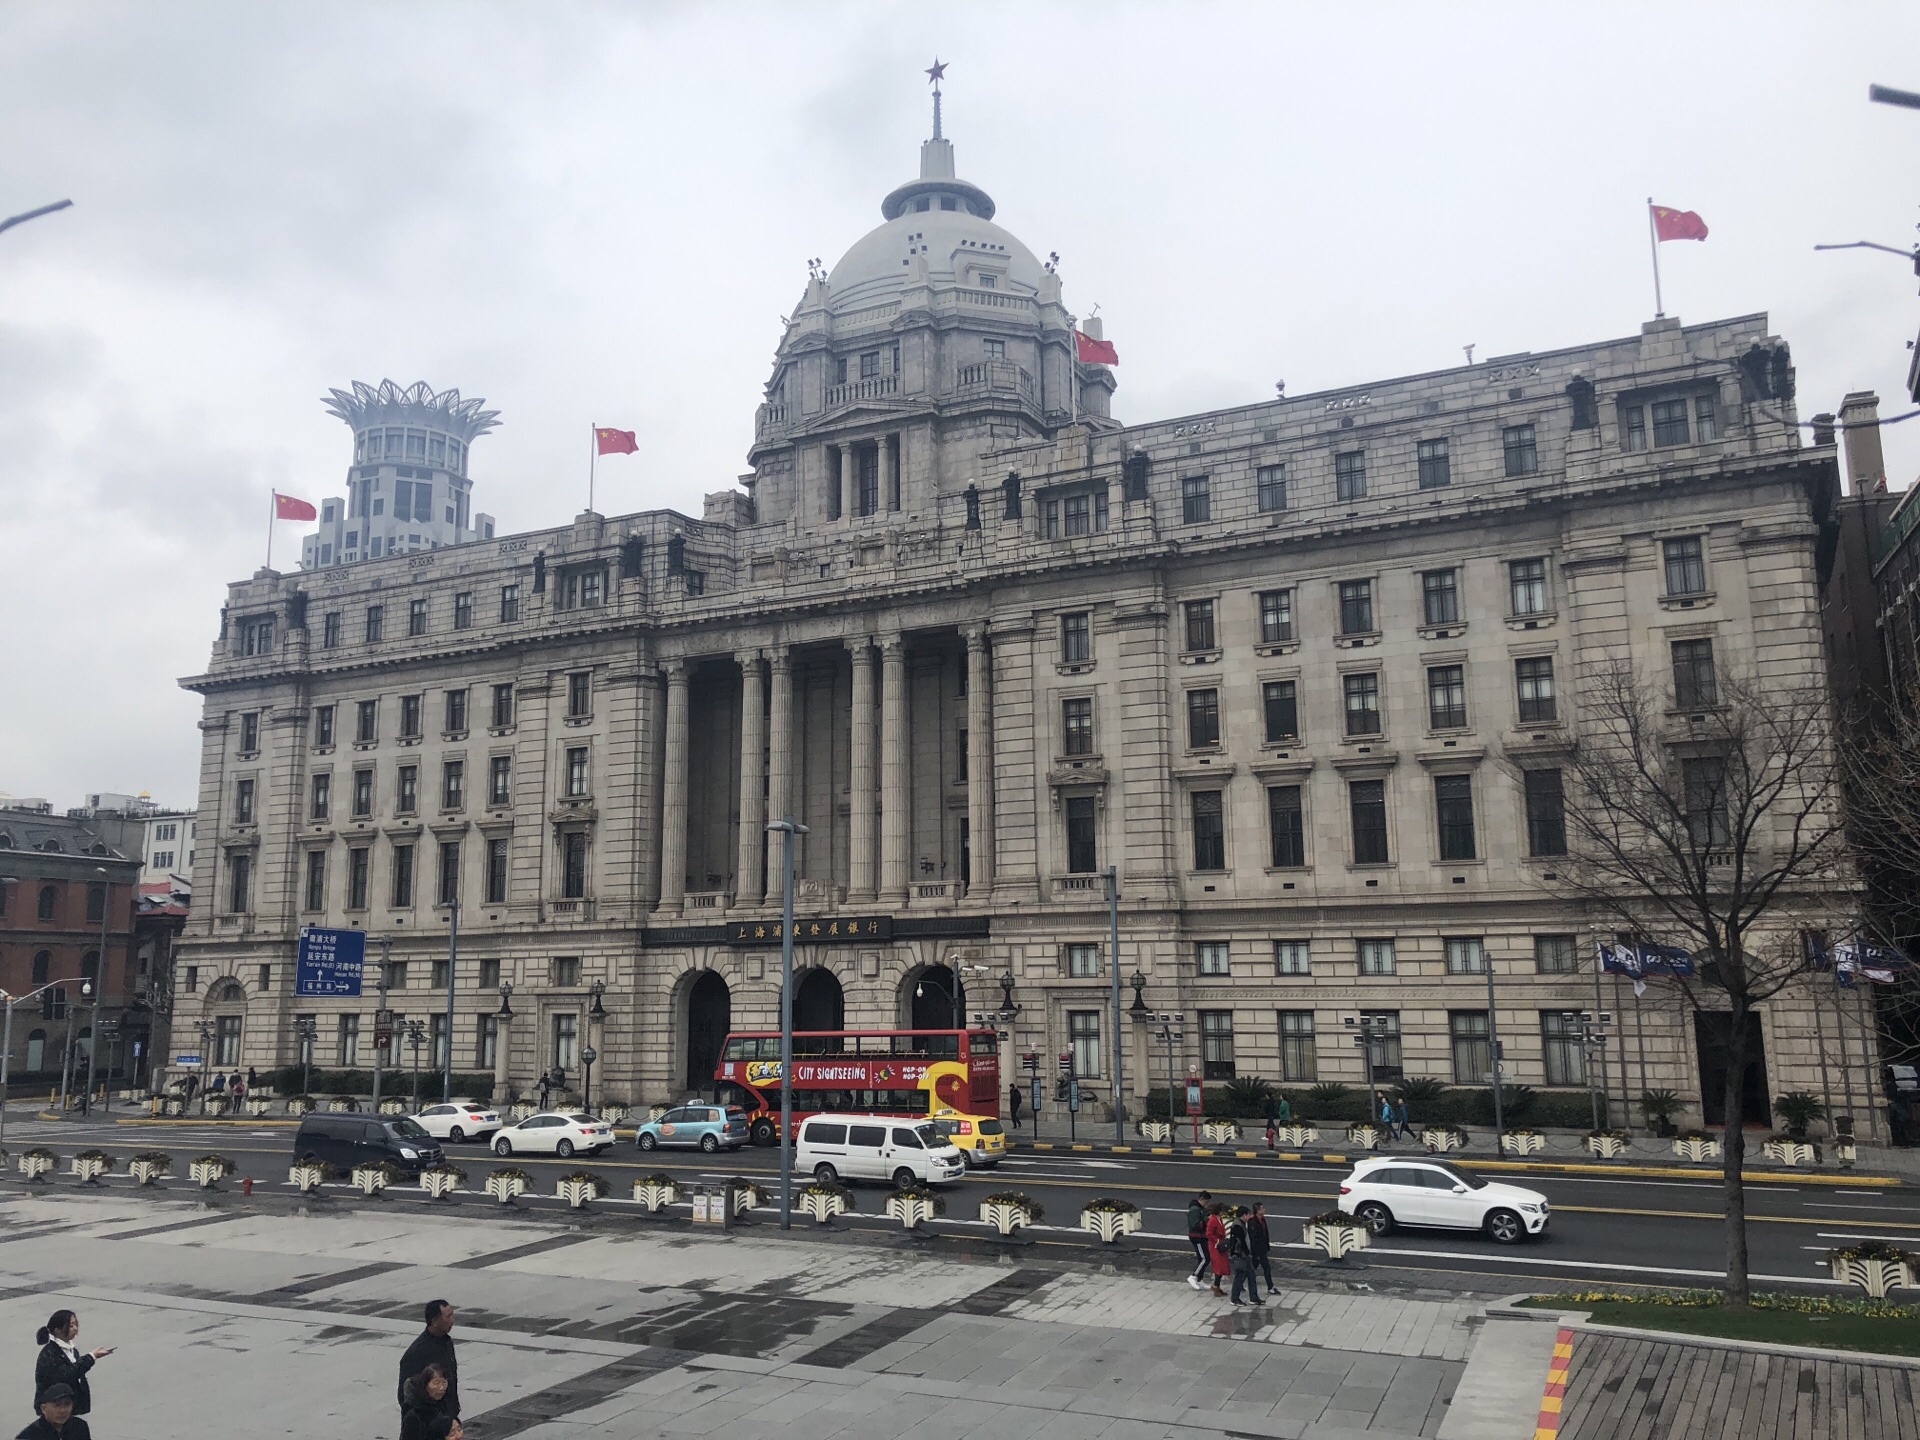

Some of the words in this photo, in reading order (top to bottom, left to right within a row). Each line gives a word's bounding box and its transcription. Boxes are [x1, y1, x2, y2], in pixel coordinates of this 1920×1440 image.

[737, 921, 879, 940] 上海浦東發展銀行
[309, 934, 337, 944] 南浦大桥
[307, 952, 335, 961] 延安东路
[335, 962, 362, 971] 河南中路
[798, 1066, 815, 1080] CITY
[816, 1066, 866, 1080] SIGHTSEEING
